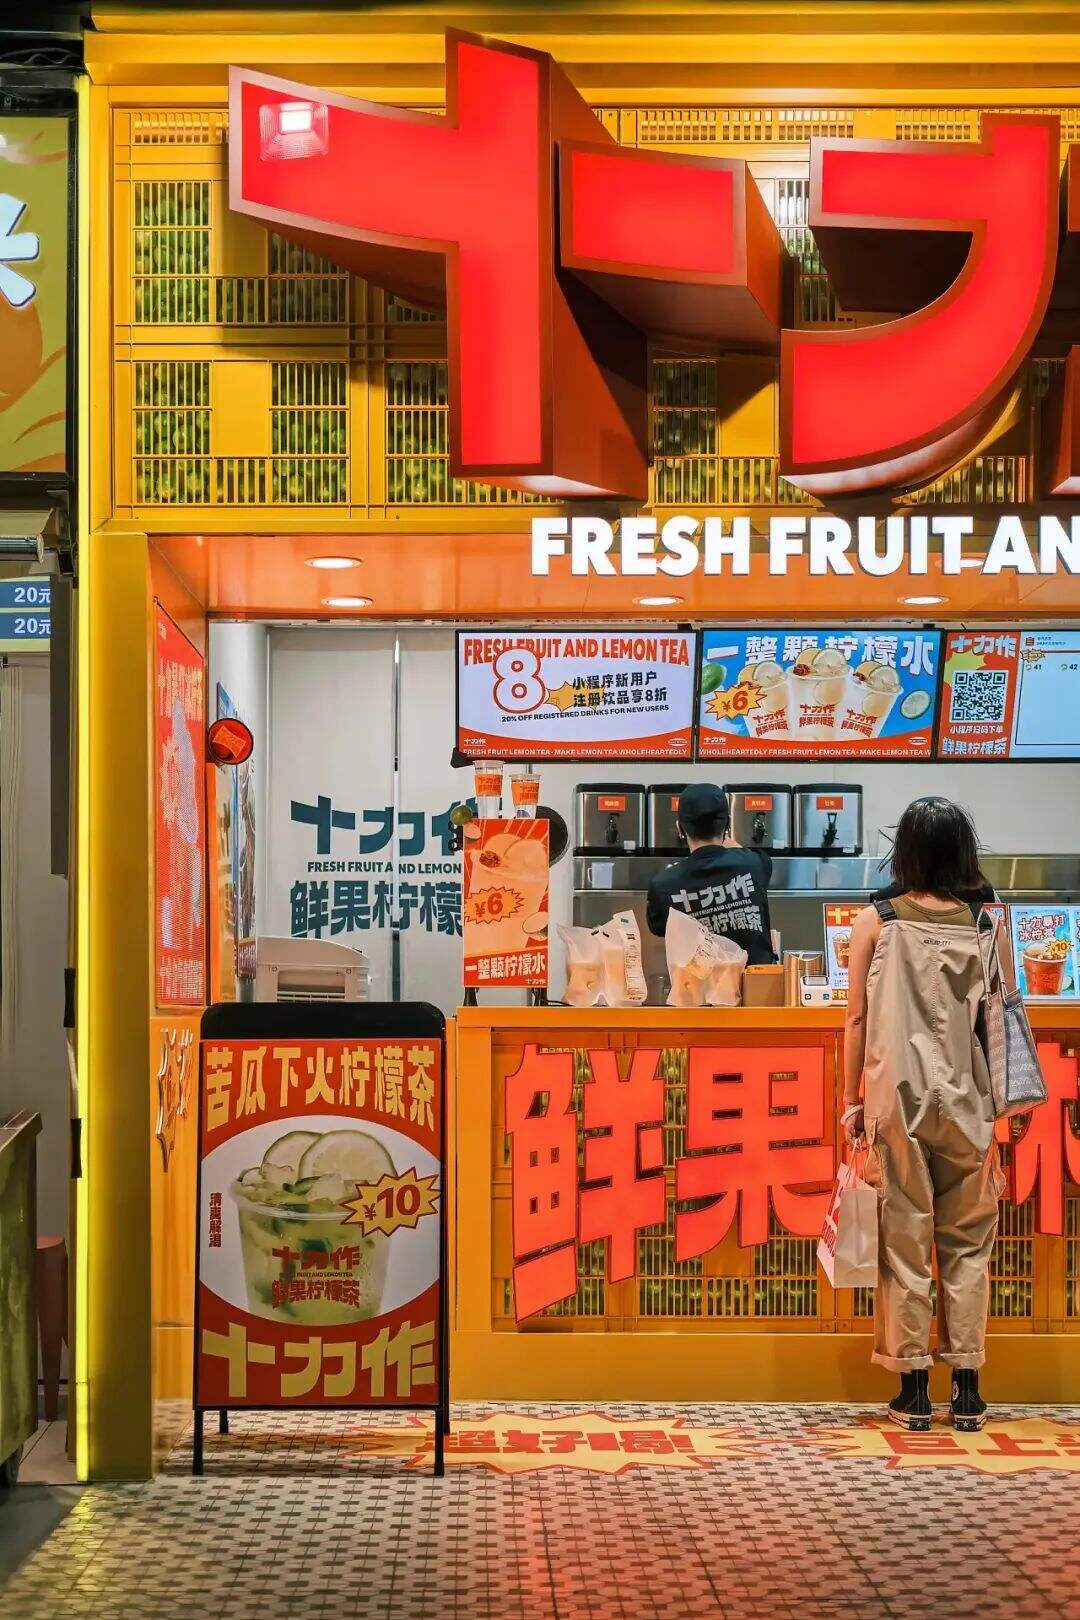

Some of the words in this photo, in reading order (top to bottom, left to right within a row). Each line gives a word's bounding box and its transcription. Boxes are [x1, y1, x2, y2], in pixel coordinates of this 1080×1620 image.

[531, 516, 750, 577] FRESH
[769, 516, 974, 577] FRUIT
[14, 586, 51, 604] 20元
[14, 617, 51, 635] 20元
[563, 638, 599, 658] AND
[601, 638, 657, 662] LEMON
[660, 638, 690, 667] TEA
[707, 635, 934, 676] 一整颗柠檬水
[950, 634, 1017, 658] 十力作
[492, 648, 548, 714] 8
[572, 671, 658, 691] 小程序新用户
[572, 687, 668, 708] 注册饮品享8折
[722, 690, 749, 712] ¥6
[534, 711, 580, 720] REGISTERED
[580, 708, 610, 718] DRINKS
[610, 707, 626, 715] FOR
[626, 705, 645, 714] NEW
[645, 704, 669, 713] USERS
[768, 748, 792, 756] FRESH
[792, 748, 814, 756] FRUIT
[815, 748, 841, 756] LEMON
[842, 748, 856, 756] TEA
[860, 748, 881, 756] MAKE
[881, 748, 908, 756] LEMON
[909, 748, 924, 756] TEA
[307, 861, 345, 873] FRESH
[347, 862, 383, 873] FRUIT
[385, 862, 416, 874] AND
[418, 863, 462, 874] LEMON
[671, 872, 755, 913] 十力作
[475, 893, 503, 918] ¥6
[465, 952, 546, 980] 一整颗柠檬水
[206, 1045, 436, 1132] 苦瓜下火柠檬茶
[363, 1184, 421, 1221] ¥10
[271, 1245, 362, 1270] 十力作
[271, 1279, 360, 1310] 鲜果柠檬茶
[202, 1320, 436, 1398] 十力作
